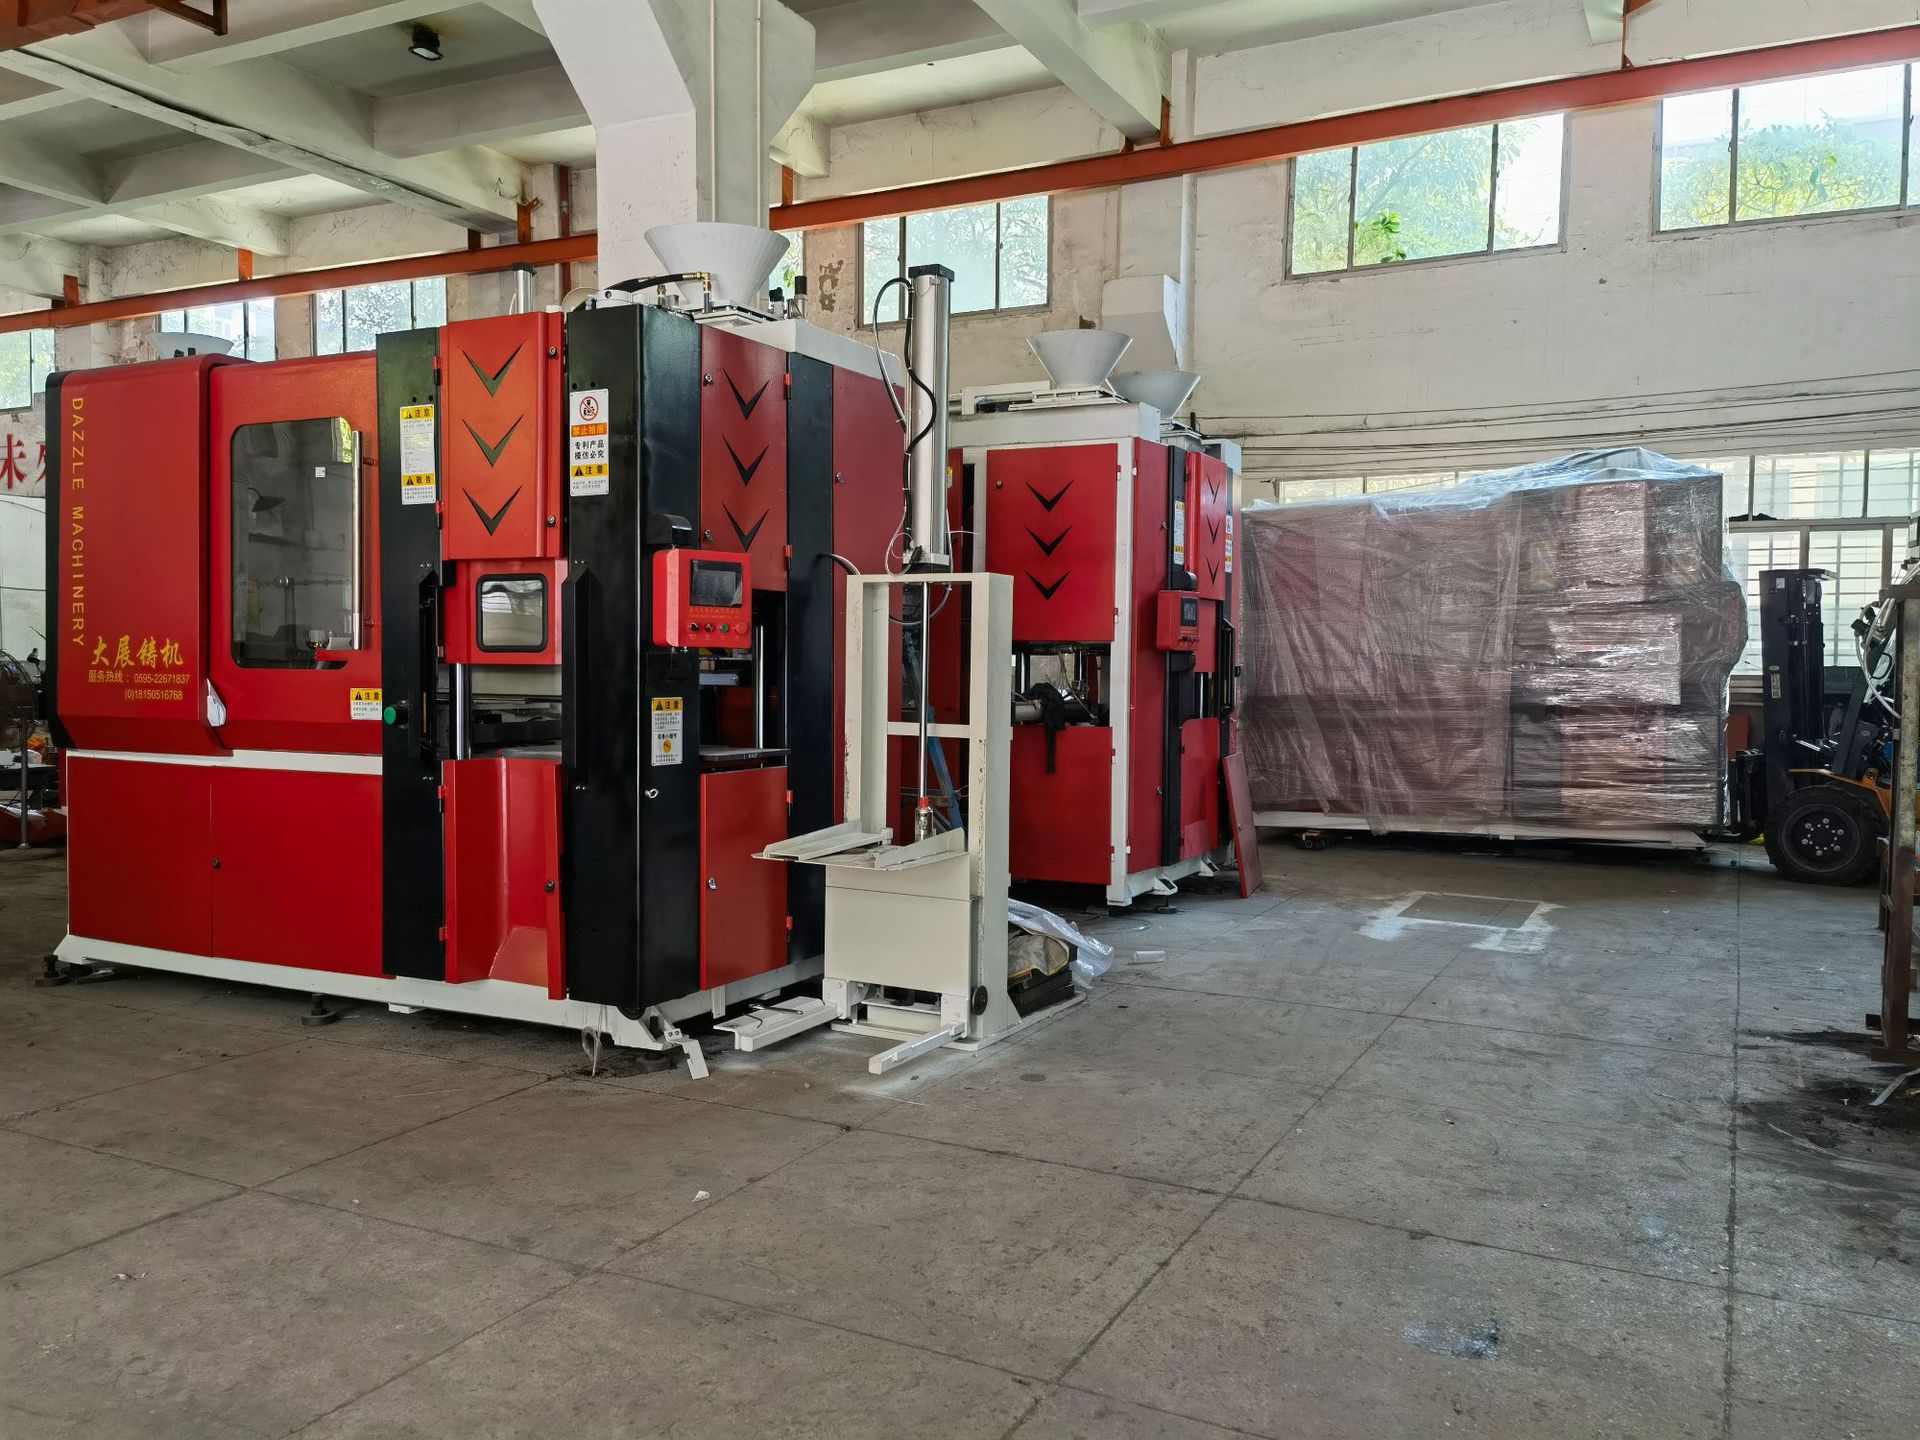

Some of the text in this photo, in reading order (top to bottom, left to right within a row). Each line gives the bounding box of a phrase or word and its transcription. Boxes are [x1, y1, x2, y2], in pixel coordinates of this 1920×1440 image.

[572, 424, 604, 437] 禁止拍照
[574, 439, 605, 450] 专利产品
[574, 449, 605, 461] 模仿必究
[585, 464, 604, 475] 注意
[71, 397, 86, 646] DAZZLE MACHINERY
[91, 634, 185, 669] 大展铸机
[133, 673, 191, 685] 0595-22671837
[124, 688, 184, 702] (0)18150516768
